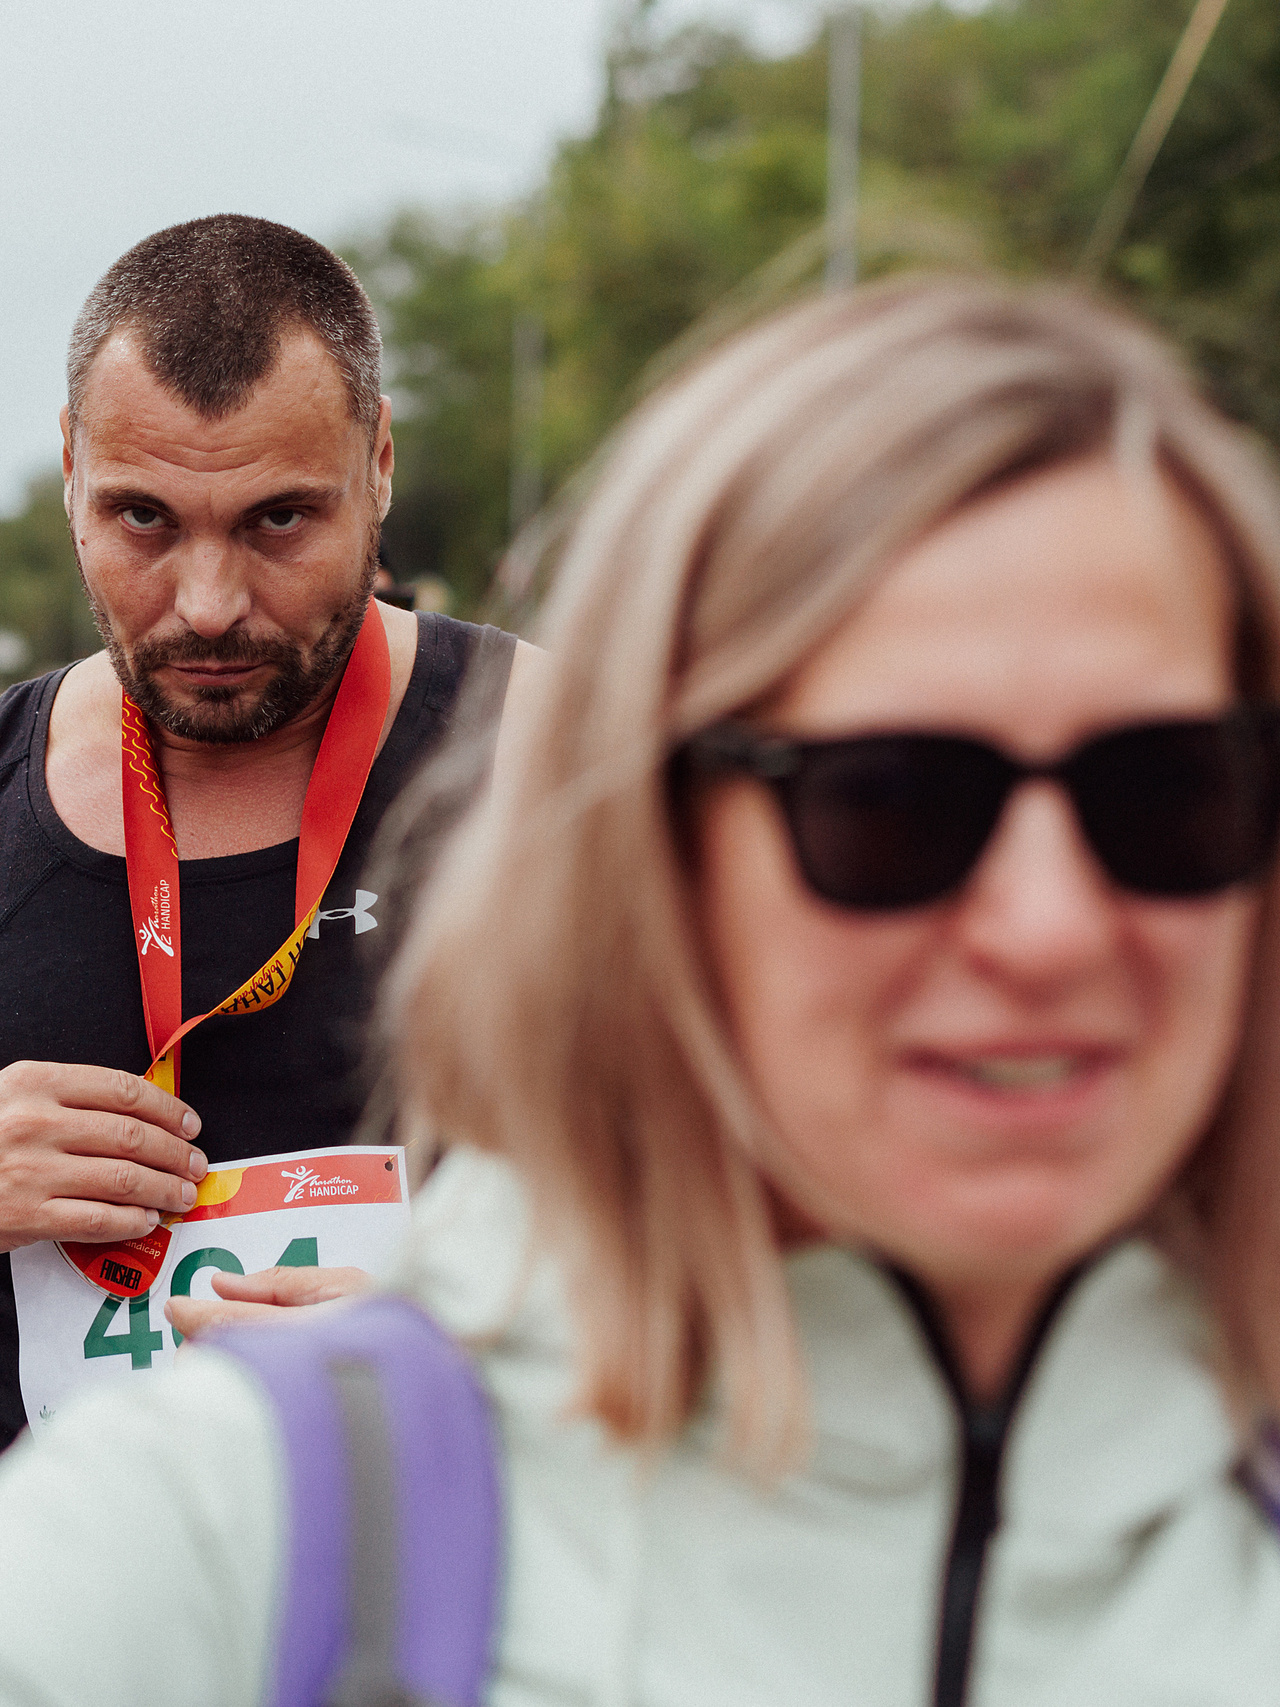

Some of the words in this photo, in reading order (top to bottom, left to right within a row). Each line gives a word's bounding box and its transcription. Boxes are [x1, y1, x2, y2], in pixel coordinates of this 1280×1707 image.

[160, 879, 171, 930] HANDICAP
[309, 1184, 359, 1198] HANDICAP
[100, 1258, 142, 1290] FINISHER
